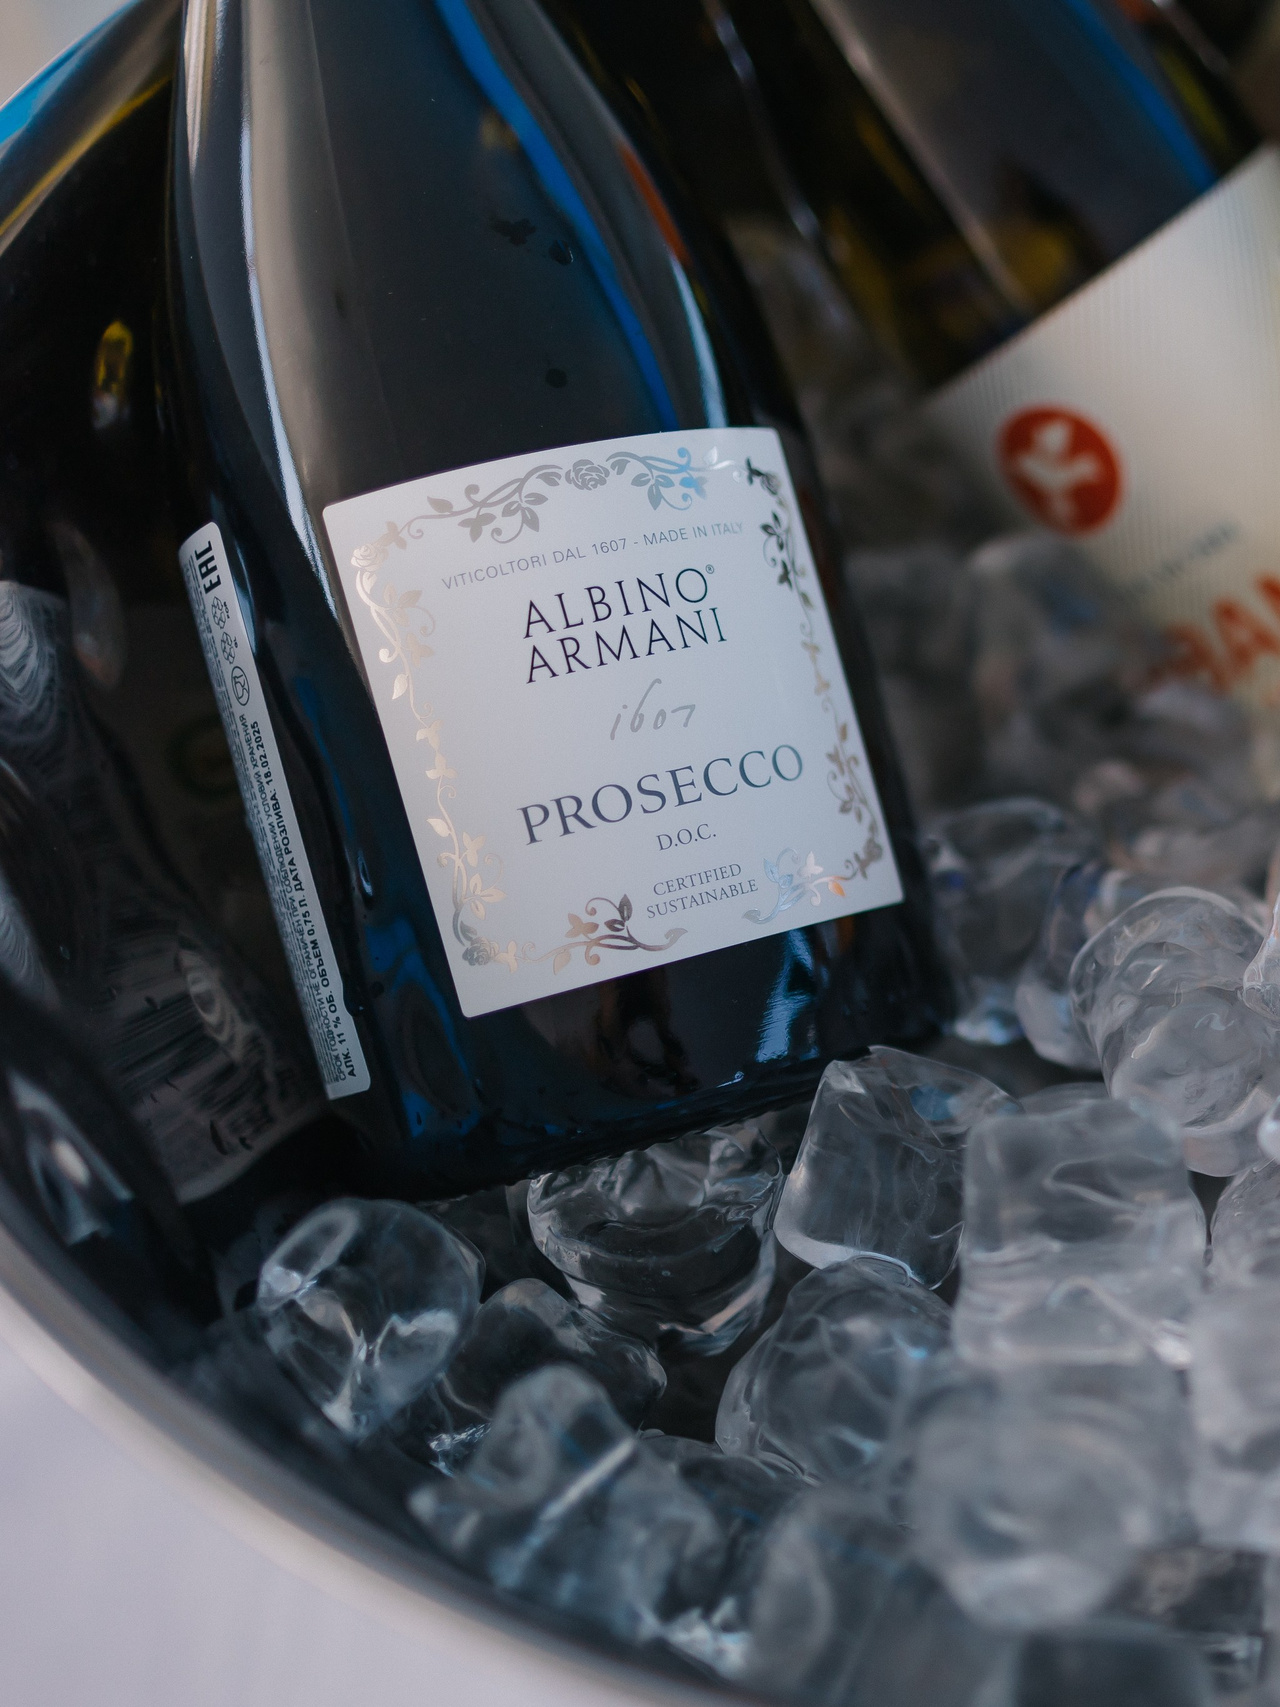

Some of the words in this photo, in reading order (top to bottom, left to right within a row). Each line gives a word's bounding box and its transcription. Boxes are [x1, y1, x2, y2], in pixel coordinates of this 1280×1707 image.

[441, 554, 548, 590] VITICOLTORI
[552, 546, 586, 565] DAL
[591, 538, 628, 556] 1607
[643, 527, 688, 547] MADE
[691, 525, 708, 539] IN
[710, 522, 744, 538] ITALY
[526, 607, 728, 684] ARMANI
[238, 713, 259, 769] ХРАНЕНИЯ
[250, 720, 273, 785] 18.02.2025
[252, 770, 272, 820] УСЛОВИЙ
[517, 744, 803, 846] PROSECCO
[268, 788, 292, 854] РОЗЛИВА:
[656, 823, 717, 851] D.O.C.
[268, 821, 292, 893] СОБЛЮДЕНИИ
[286, 856, 304, 892] ДАТА
[653, 863, 742, 896] CERTIFIED
[288, 896, 299, 917] ПРИ
[297, 894, 307, 907] Л.
[646, 879, 759, 919] SUSTAINABLE
[301, 909, 315, 936] 0,75
[295, 919, 317, 979] ОГРАНИЧЕН
[309, 938, 330, 987] ОБЪЕМ
[311, 981, 321, 996] НЕ
[324, 990, 337, 1013] ОБ.
[317, 997, 338, 1051] ГОДНОСТИ
[331, 1015, 342, 1028] %
[336, 1032, 346, 1044] 11
[333, 1052, 346, 1081] СРОК
[341, 1047, 356, 1078] АЛК.
